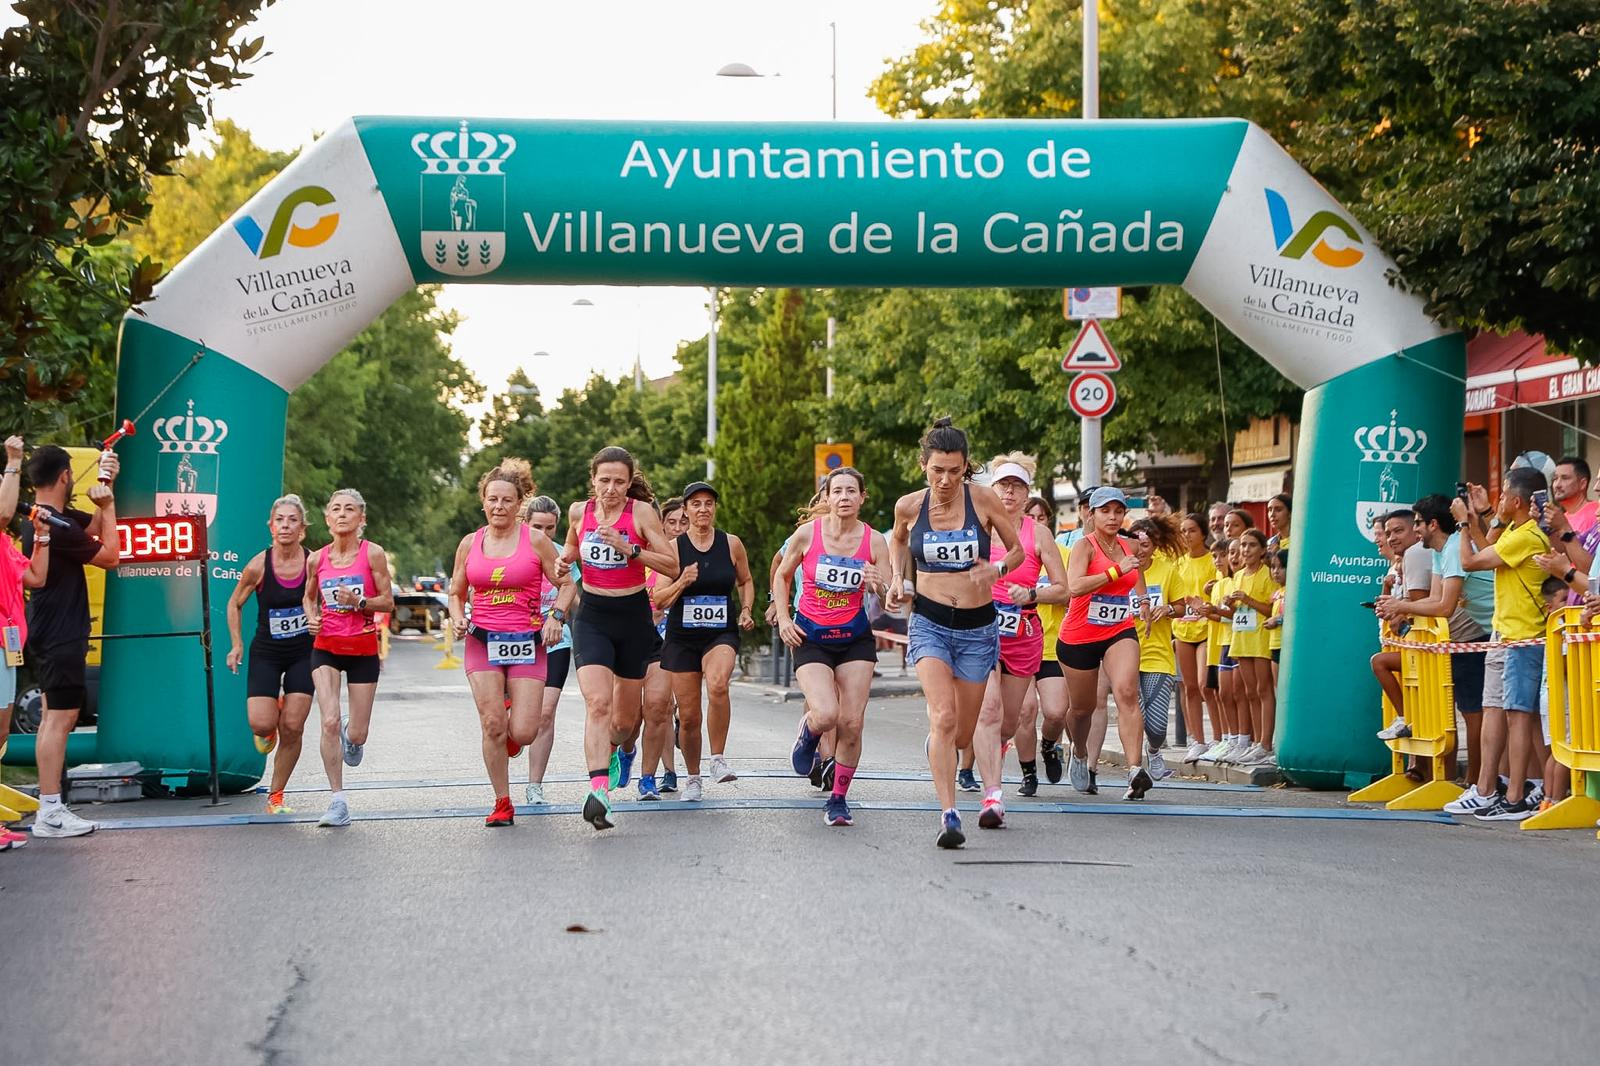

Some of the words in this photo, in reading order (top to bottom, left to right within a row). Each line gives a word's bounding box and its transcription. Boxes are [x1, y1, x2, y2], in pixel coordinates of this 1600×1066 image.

[620, 139, 1005, 189] Ayuntamiento
[1026, 140, 1092, 179] de
[523, 210, 804, 254] Villanueva
[829, 211, 893, 254] de
[917, 211, 959, 254] la
[983, 209, 1185, 254] Cañada
[236, 258, 353, 296] Villanueva
[1249, 263, 1360, 304] Villanueva
[243, 308, 257, 320] de
[258, 305, 270, 317] la
[271, 278, 356, 313] Cañada
[1243, 295, 1256, 305] de
[1258, 297, 1267, 309] la
[1271, 292, 1355, 328] Cañada
[1081, 386, 1104, 401] 20
[223, 550, 239, 562] de
[590, 545, 625, 563] 815
[936, 543, 975, 561] 811
[117, 565, 172, 578] Villanueva
[175, 564, 192, 577] de
[212, 566, 243, 580] Caña
[826, 568, 862, 586] 810
[1311, 571, 1372, 585] Villanueva
[692, 607, 725, 621] 804
[998, 613, 1017, 630] 02
[1098, 605, 1128, 620] 817
[280, 614, 310, 632] 812
[498, 643, 533, 657] 805
